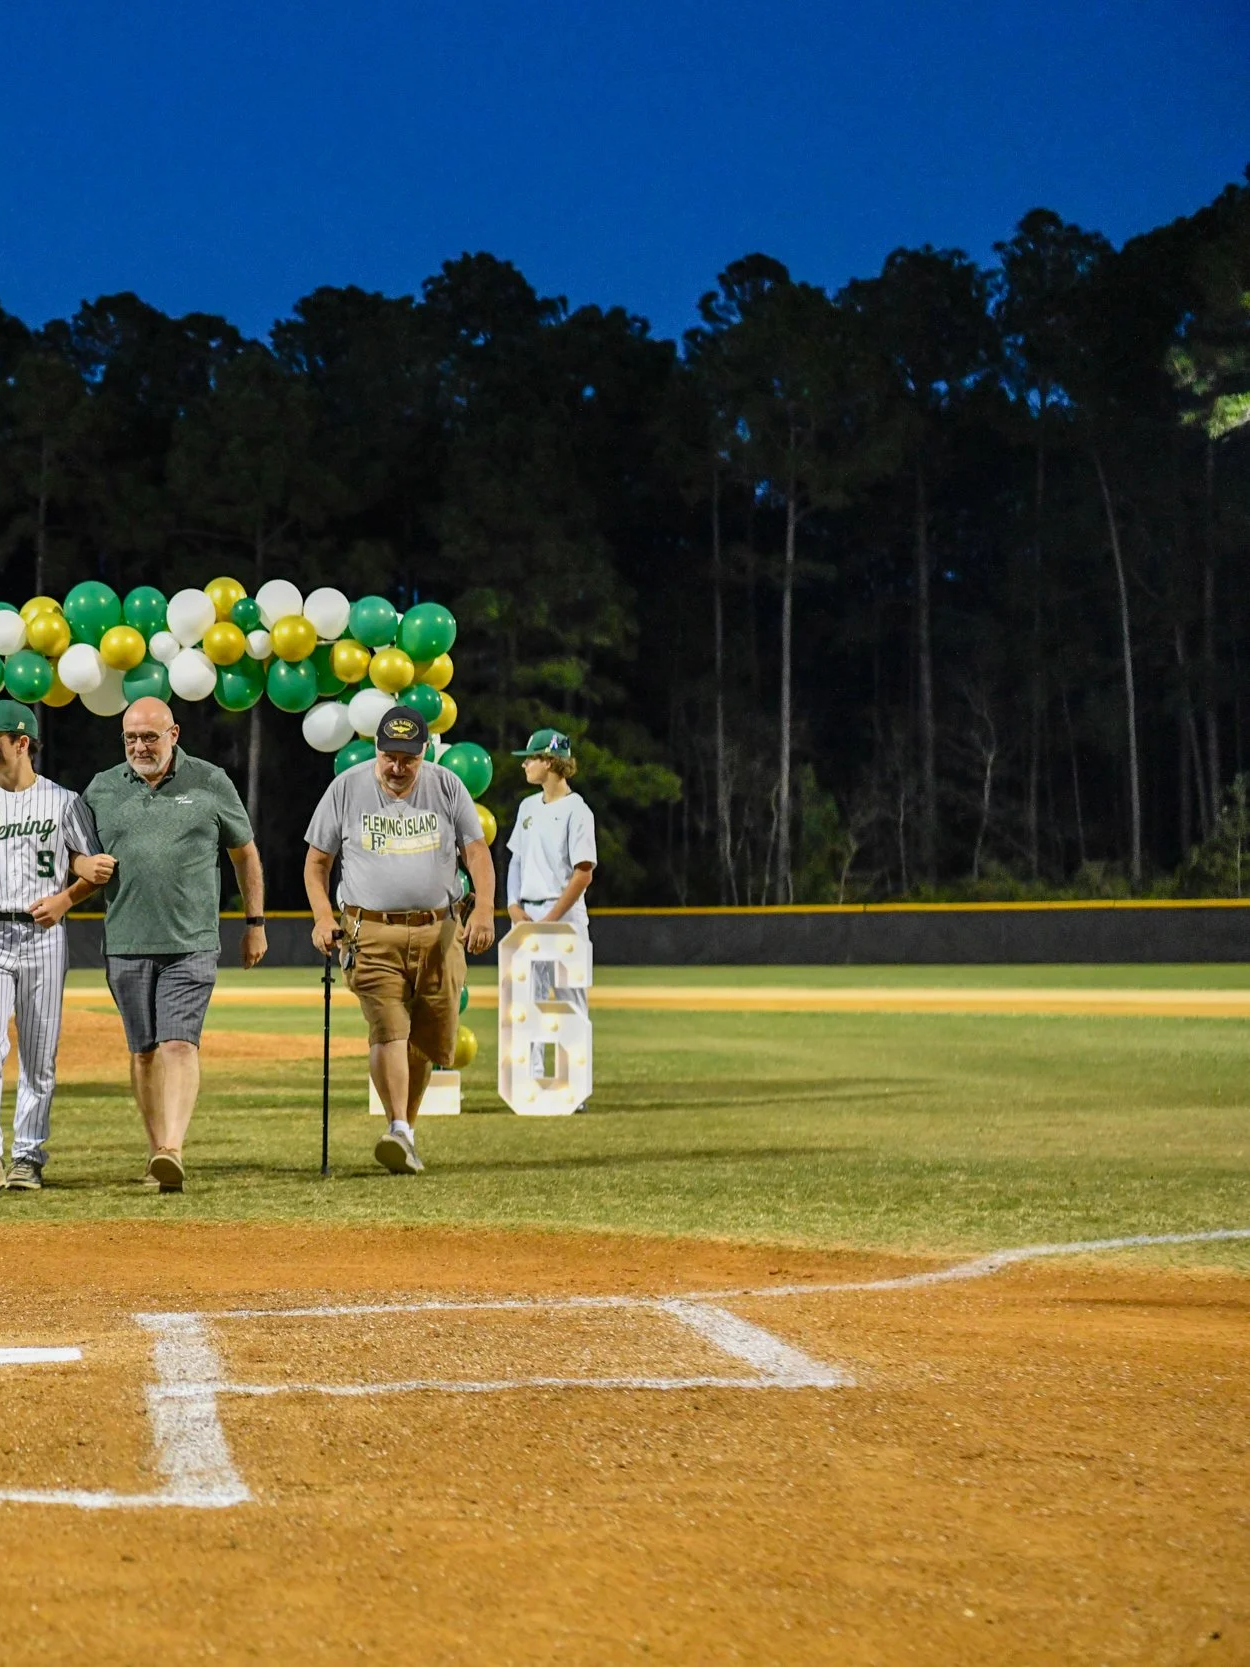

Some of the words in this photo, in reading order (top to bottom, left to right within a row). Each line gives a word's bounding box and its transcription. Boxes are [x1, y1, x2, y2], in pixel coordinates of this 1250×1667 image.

[362, 814, 403, 837] FLEMING
[404, 813, 438, 836] ISLAND
[37, 850, 55, 878] 9
